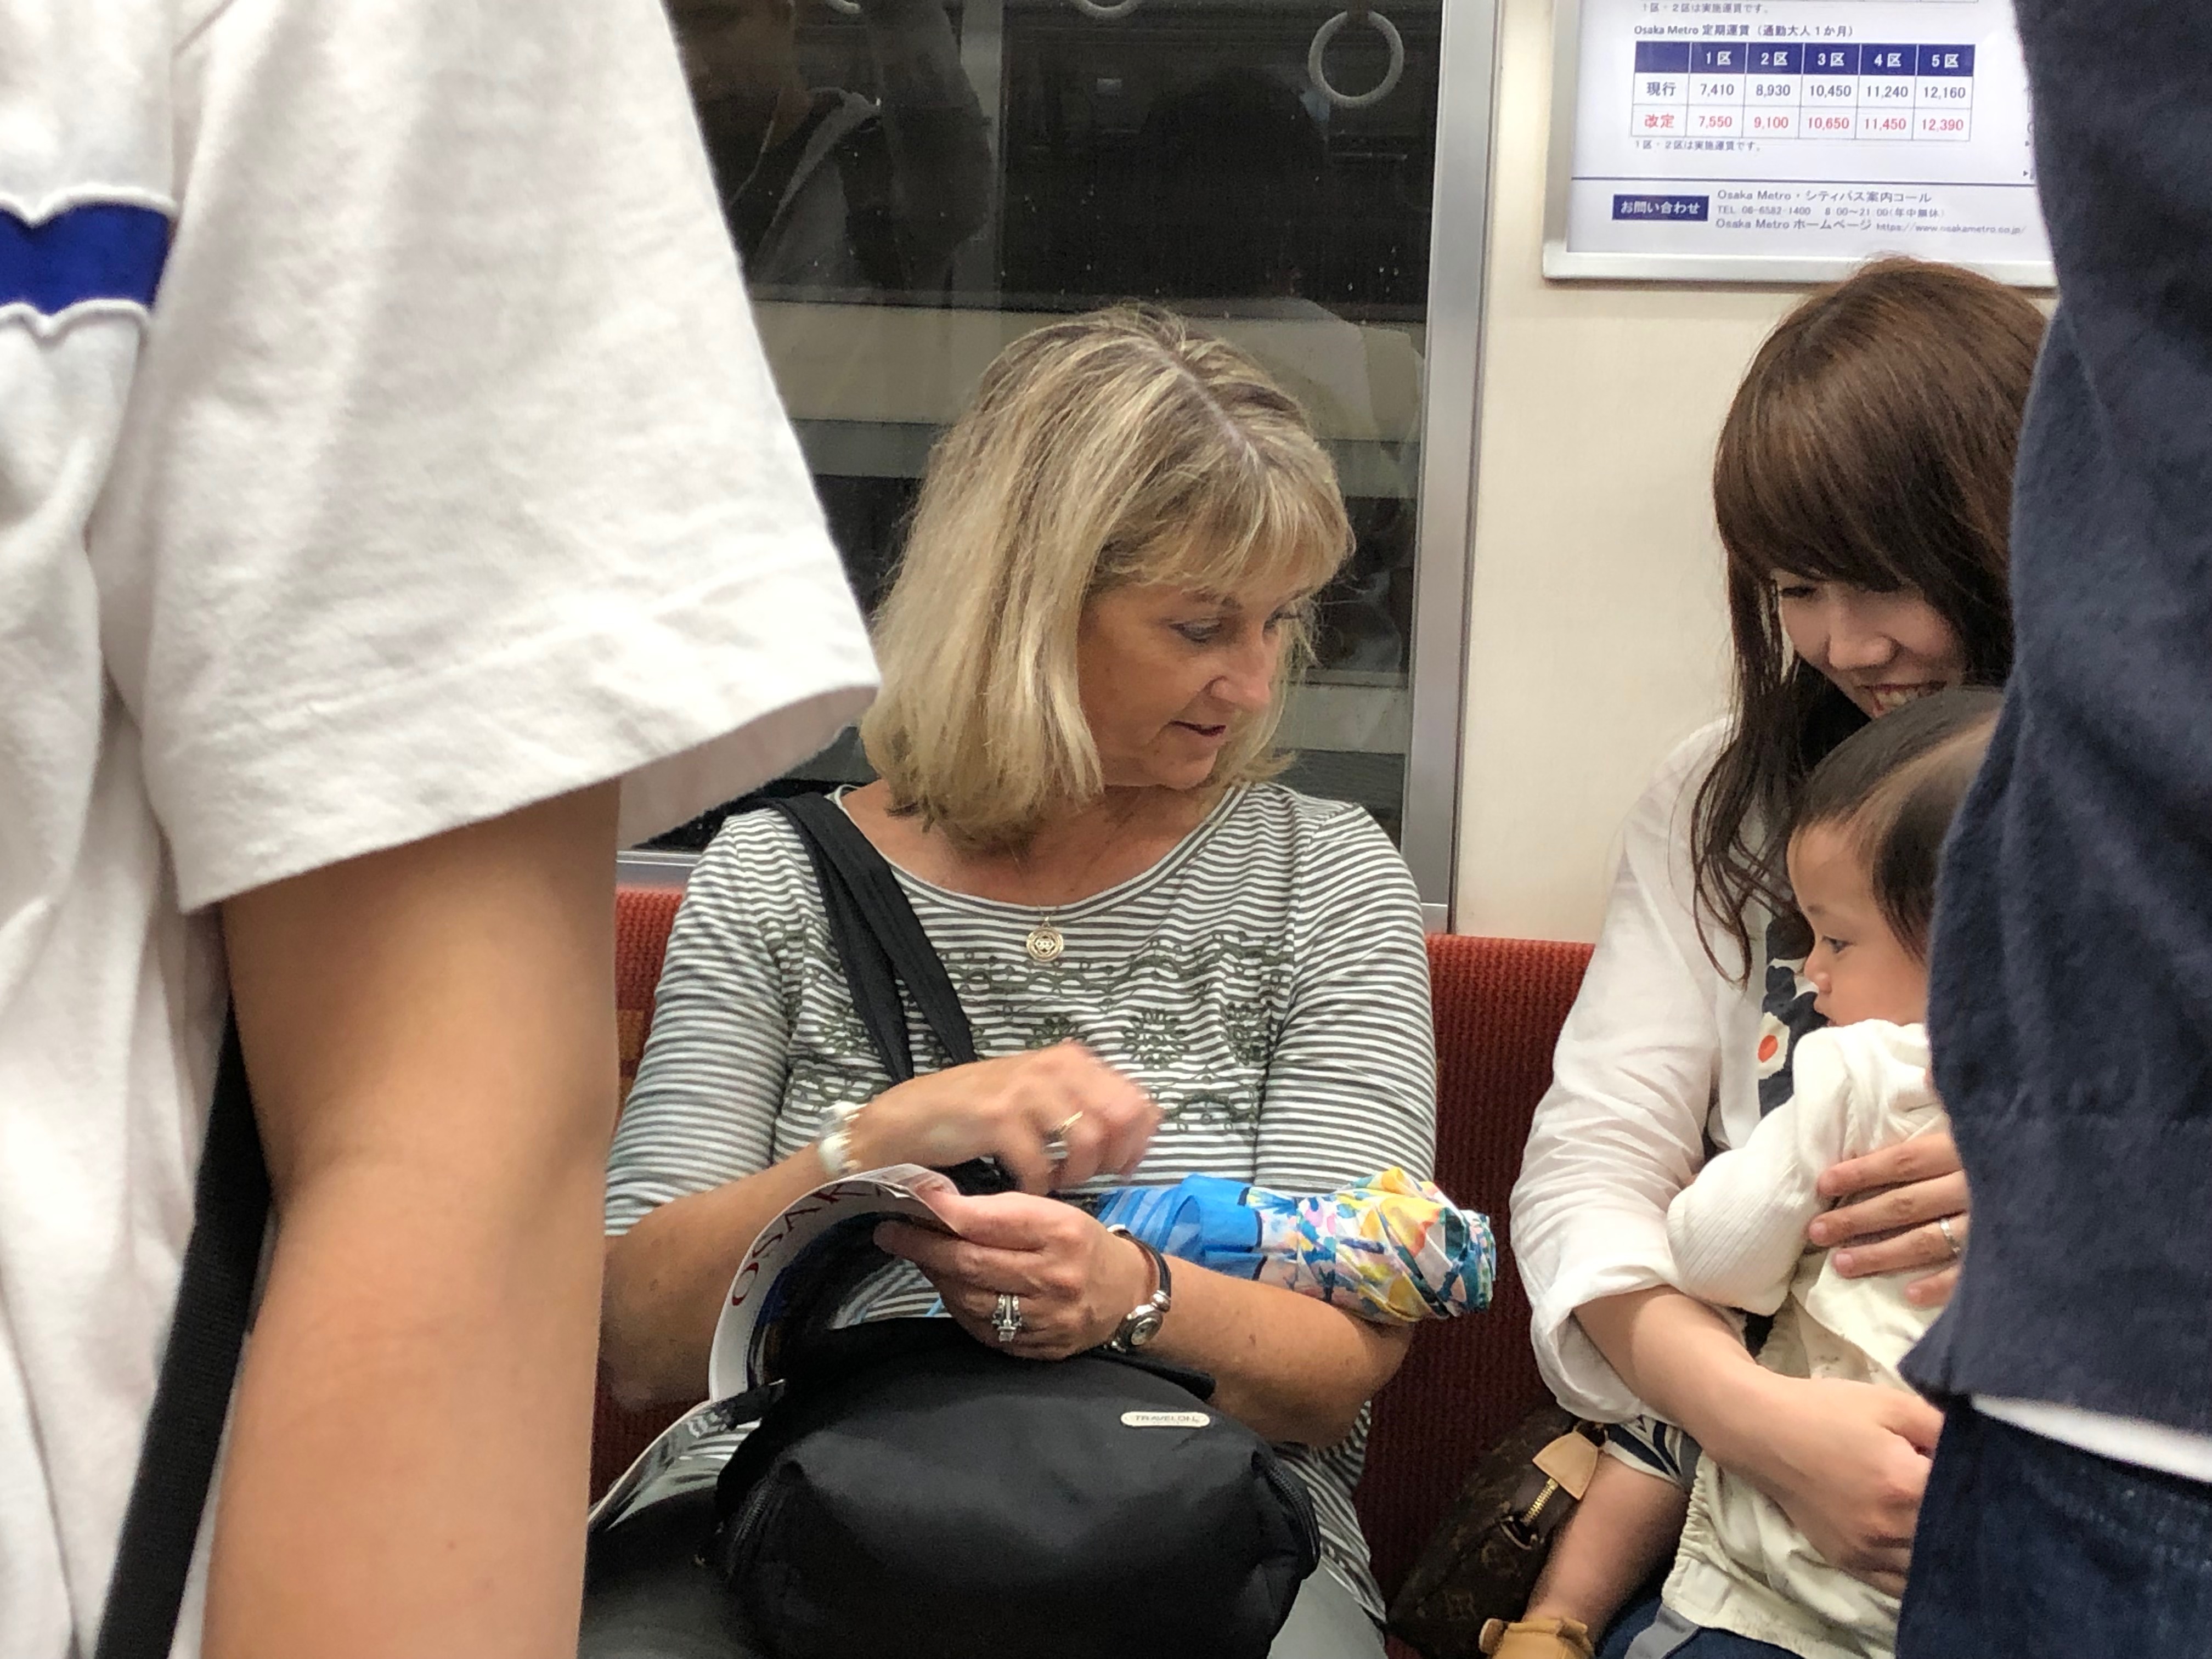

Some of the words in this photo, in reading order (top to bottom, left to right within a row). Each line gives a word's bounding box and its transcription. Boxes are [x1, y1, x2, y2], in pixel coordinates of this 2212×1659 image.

[1634, 25, 1664, 35] Osaka
[1667, 25, 1699, 35] Metro
[1706, 51, 1731, 66] 1区
[1760, 52, 1788, 66] 2区
[1817, 52, 1844, 66] 3区
[1874, 53, 1901, 67] 4区
[1931, 54, 1959, 68] 5区
[1646, 82, 1677, 97] 現行
[1700, 83, 1734, 97] 7,410
[1756, 84, 1791, 98] 8,930
[1810, 84, 1852, 98] 10,450
[1867, 86, 1909, 99] 11,240
[1924, 86, 1966, 99] 12,160
[1644, 114, 1675, 128] 改定
[1699, 116, 1733, 129] 7,550
[1754, 117, 1788, 129] 9,100
[1808, 117, 1849, 130] 10,650
[1865, 118, 1906, 131] 11,450
[1922, 119, 1963, 132] 12,390
[1717, 190, 1753, 199] Osaka
[1621, 201, 1700, 215] お問い合わせ
[1718, 205, 1735, 214] TEL
[1716, 219, 1751, 228] Osaka
[1756, 219, 1790, 229] Metro
[1793, 219, 1872, 230] ホームページ
[1876, 222, 2027, 235] https://wwwosakametrocojp/
[731, 1181, 882, 1307] OSAK
